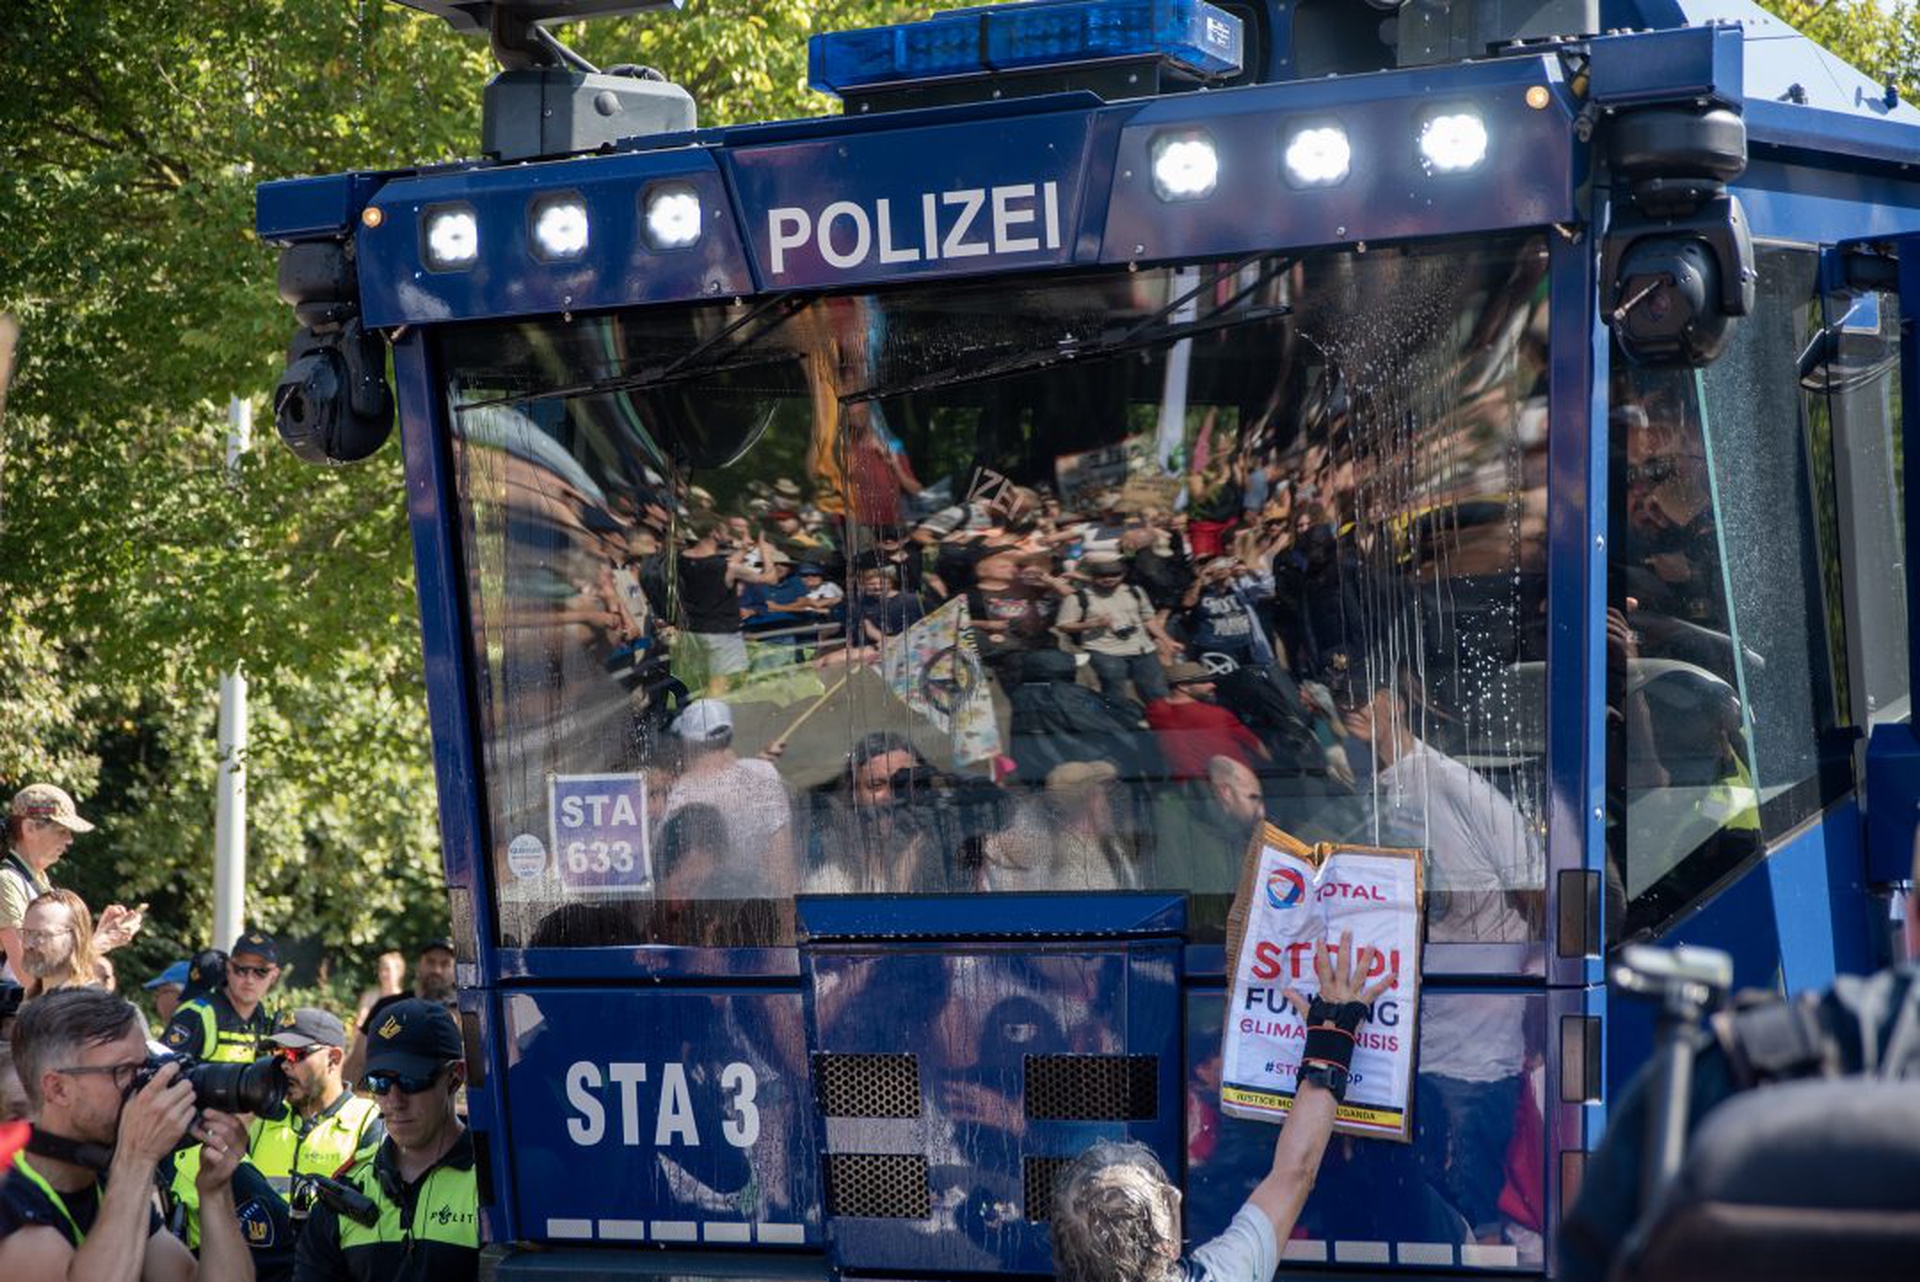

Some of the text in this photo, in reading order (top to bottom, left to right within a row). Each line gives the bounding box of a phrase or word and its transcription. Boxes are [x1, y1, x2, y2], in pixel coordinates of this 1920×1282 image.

[767, 181, 1061, 275] POLIZEI
[561, 794, 637, 828] STA
[567, 840, 635, 874] 633
[566, 1060, 761, 1148] STA 3
